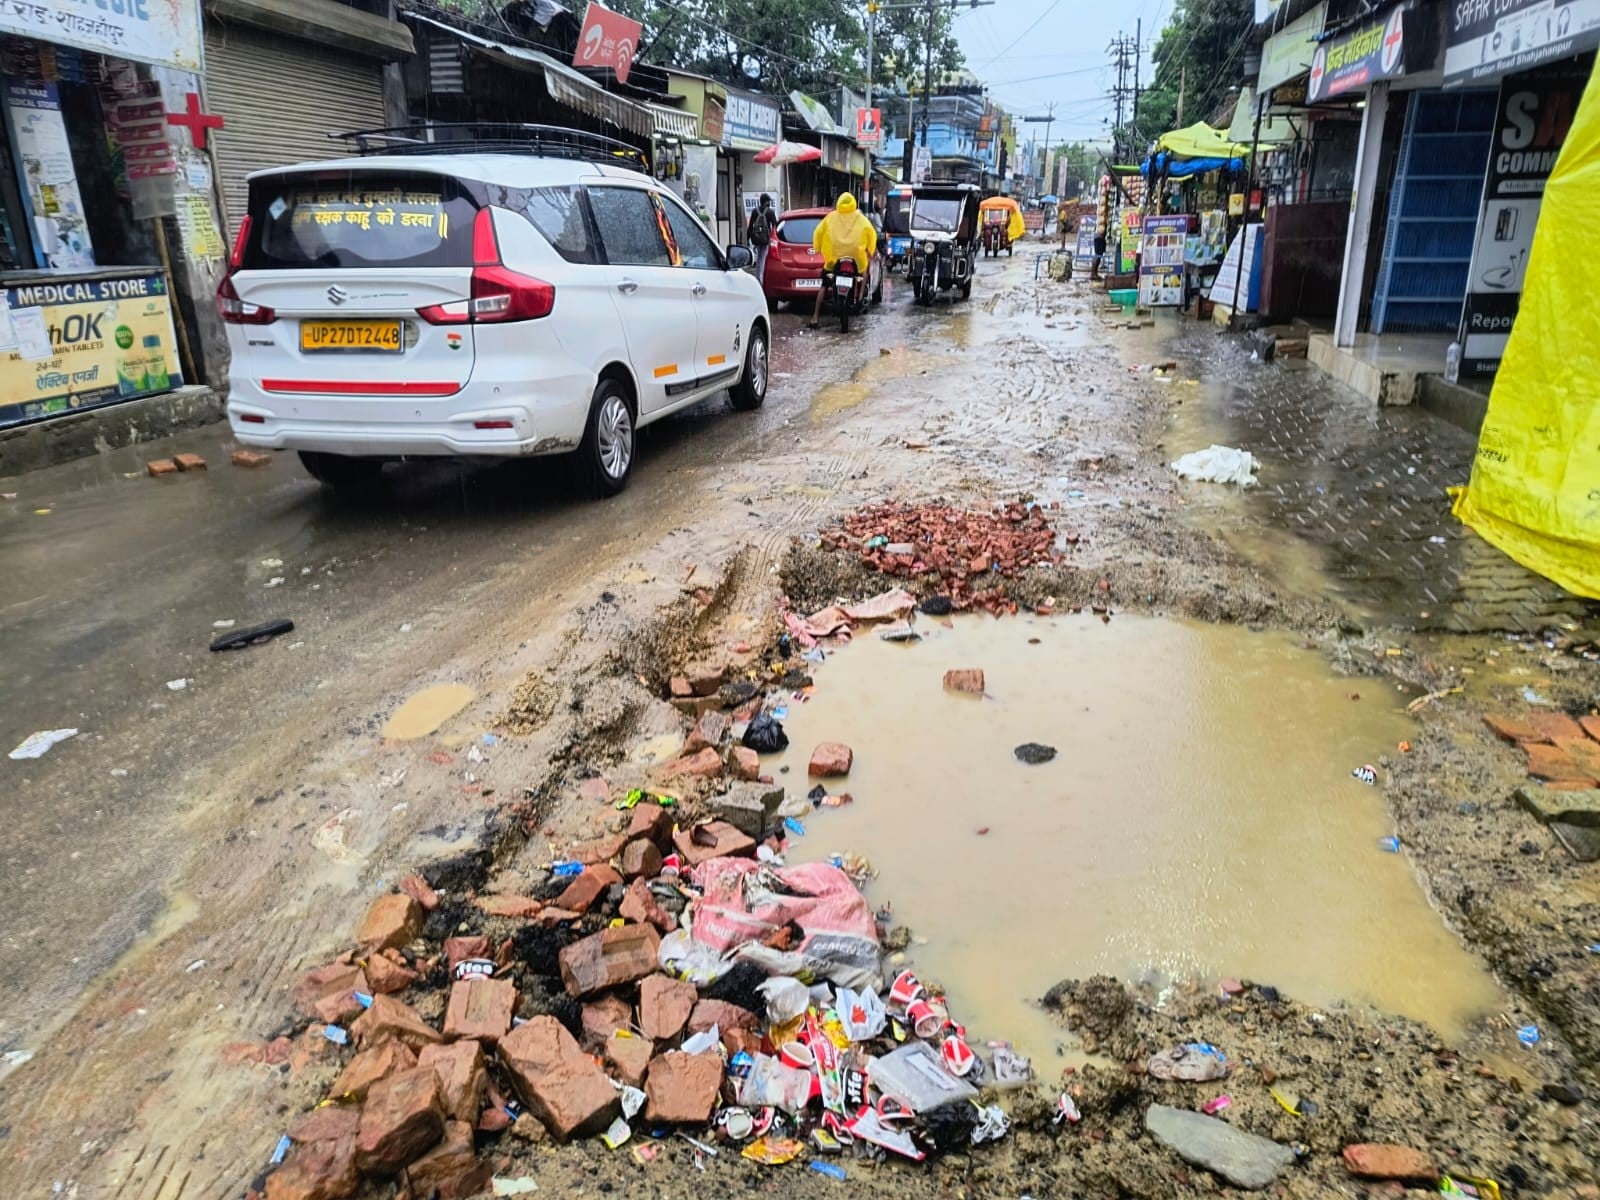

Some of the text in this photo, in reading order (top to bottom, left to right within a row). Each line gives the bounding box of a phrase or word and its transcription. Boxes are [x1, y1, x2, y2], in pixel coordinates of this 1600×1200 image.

[376, 207, 395, 226] को
[400, 212, 434, 229] डरना
[18, 278, 148, 305] MEDICAL STORE
[312, 327, 400, 344] UP27DT2448
